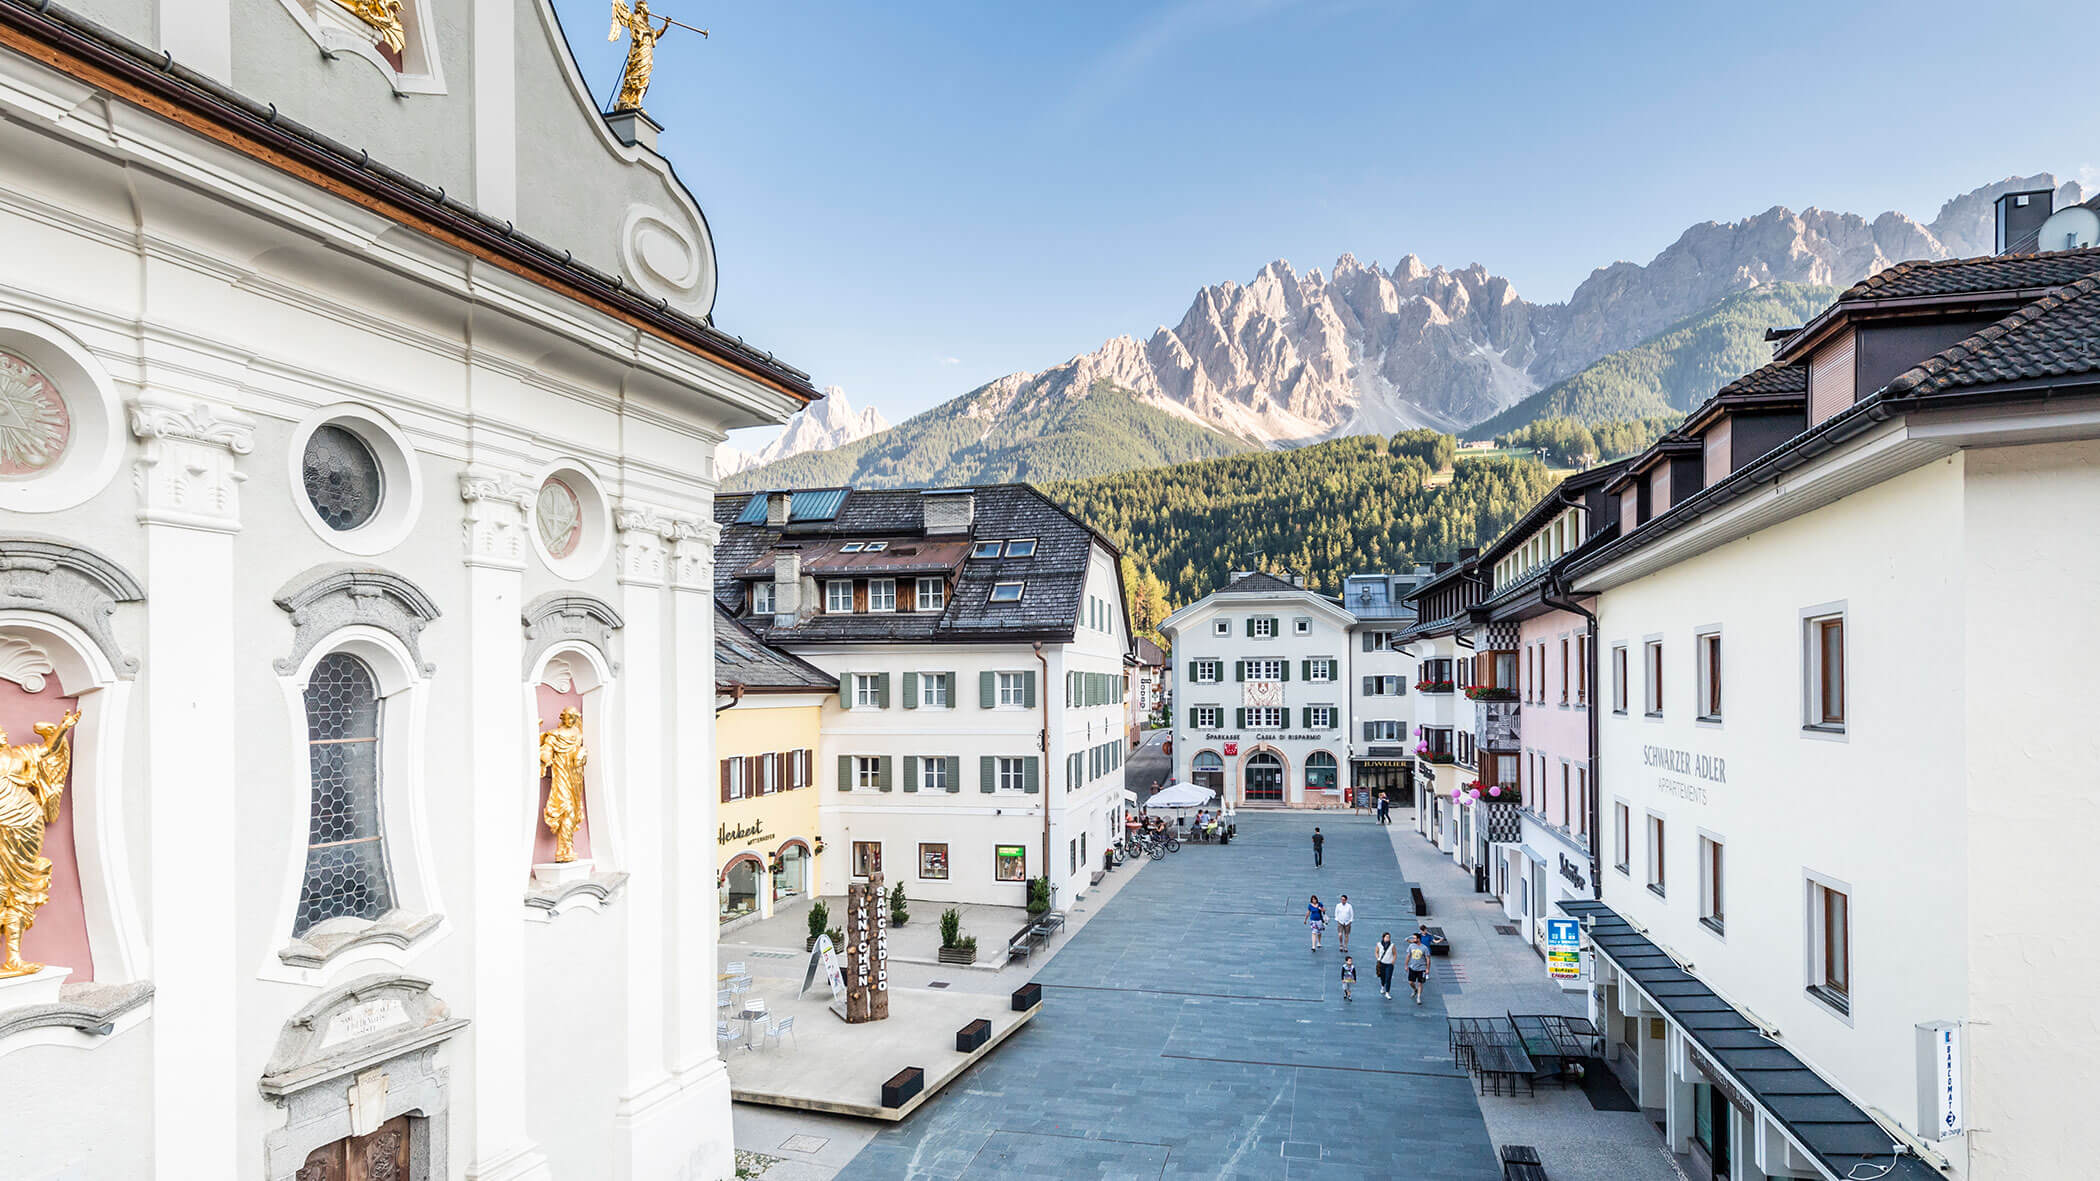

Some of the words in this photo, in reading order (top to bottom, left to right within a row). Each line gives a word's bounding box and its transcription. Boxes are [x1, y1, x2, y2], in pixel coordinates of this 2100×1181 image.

[1364, 760, 1407, 768] JUWELIER
[1643, 743, 1692, 776] SCHWARZER
[1694, 752, 1727, 785] ADLER
[1656, 775, 1708, 806] APPARTEMENTS
[717, 818, 763, 846] Herbert
[857, 896, 869, 987] INNICHEN
